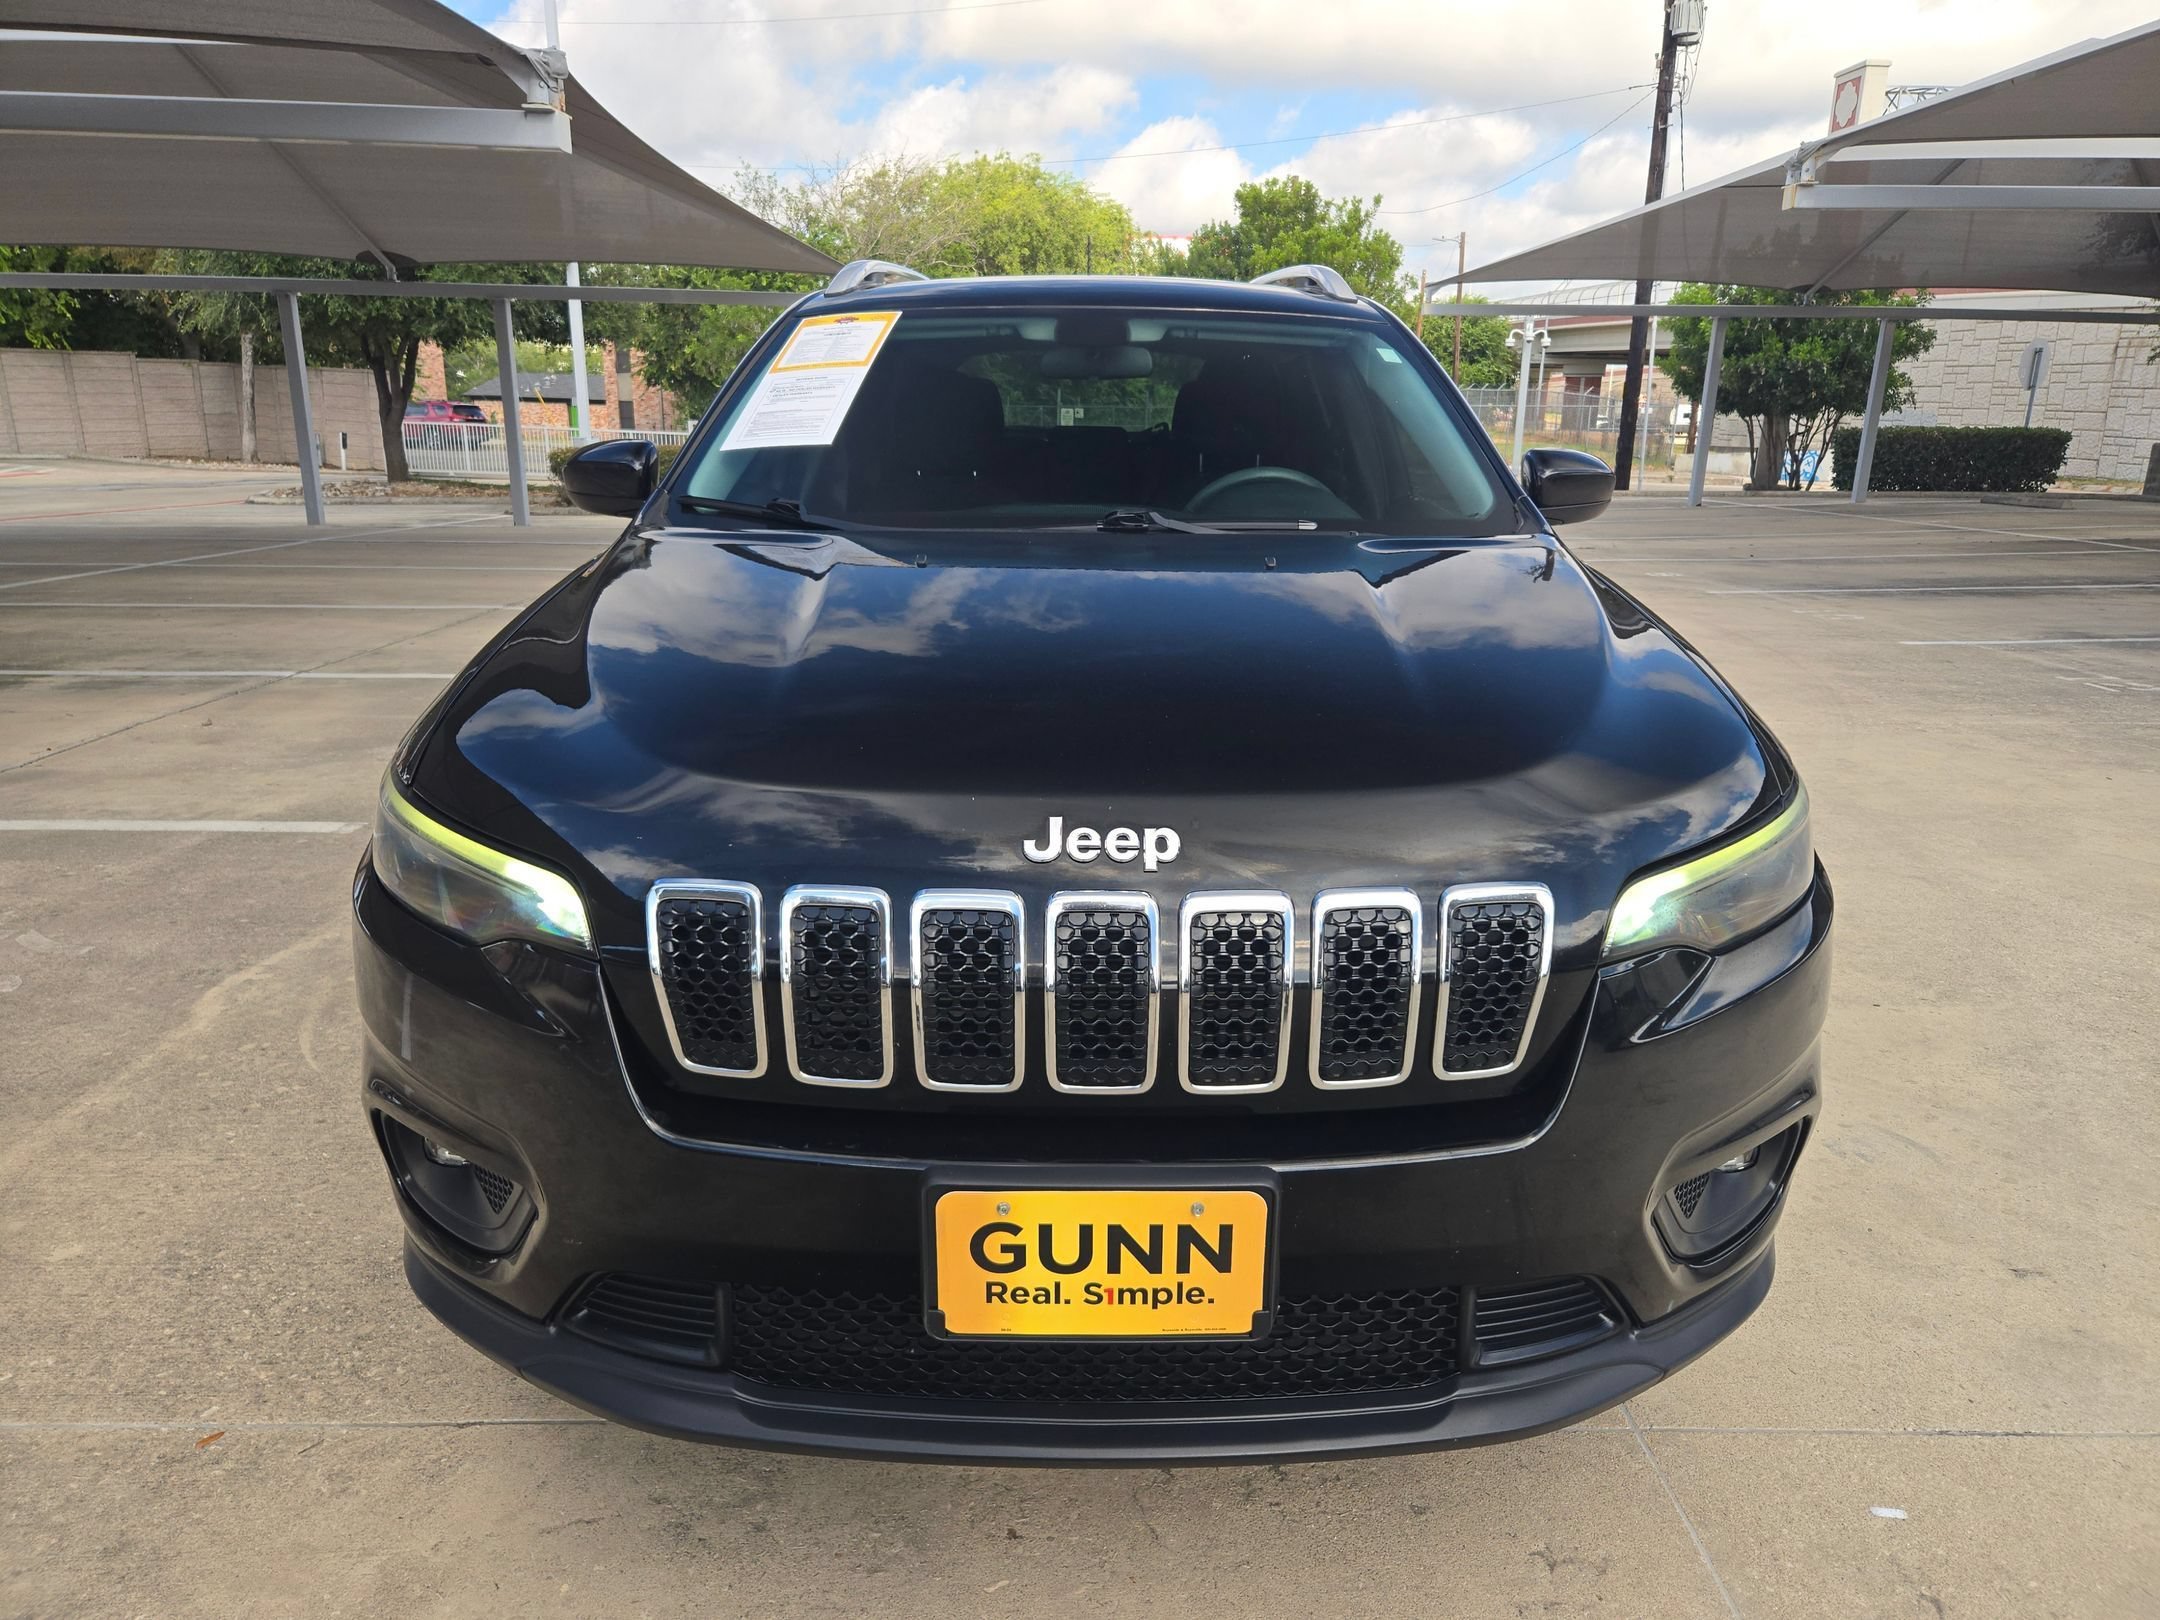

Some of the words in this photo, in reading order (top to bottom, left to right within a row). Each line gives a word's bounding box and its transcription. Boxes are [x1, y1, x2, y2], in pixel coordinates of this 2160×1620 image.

[1023, 816, 1181, 872] Jeep
[969, 1221, 1234, 1275] GUNN
[985, 1281, 1071, 1305] Real.
